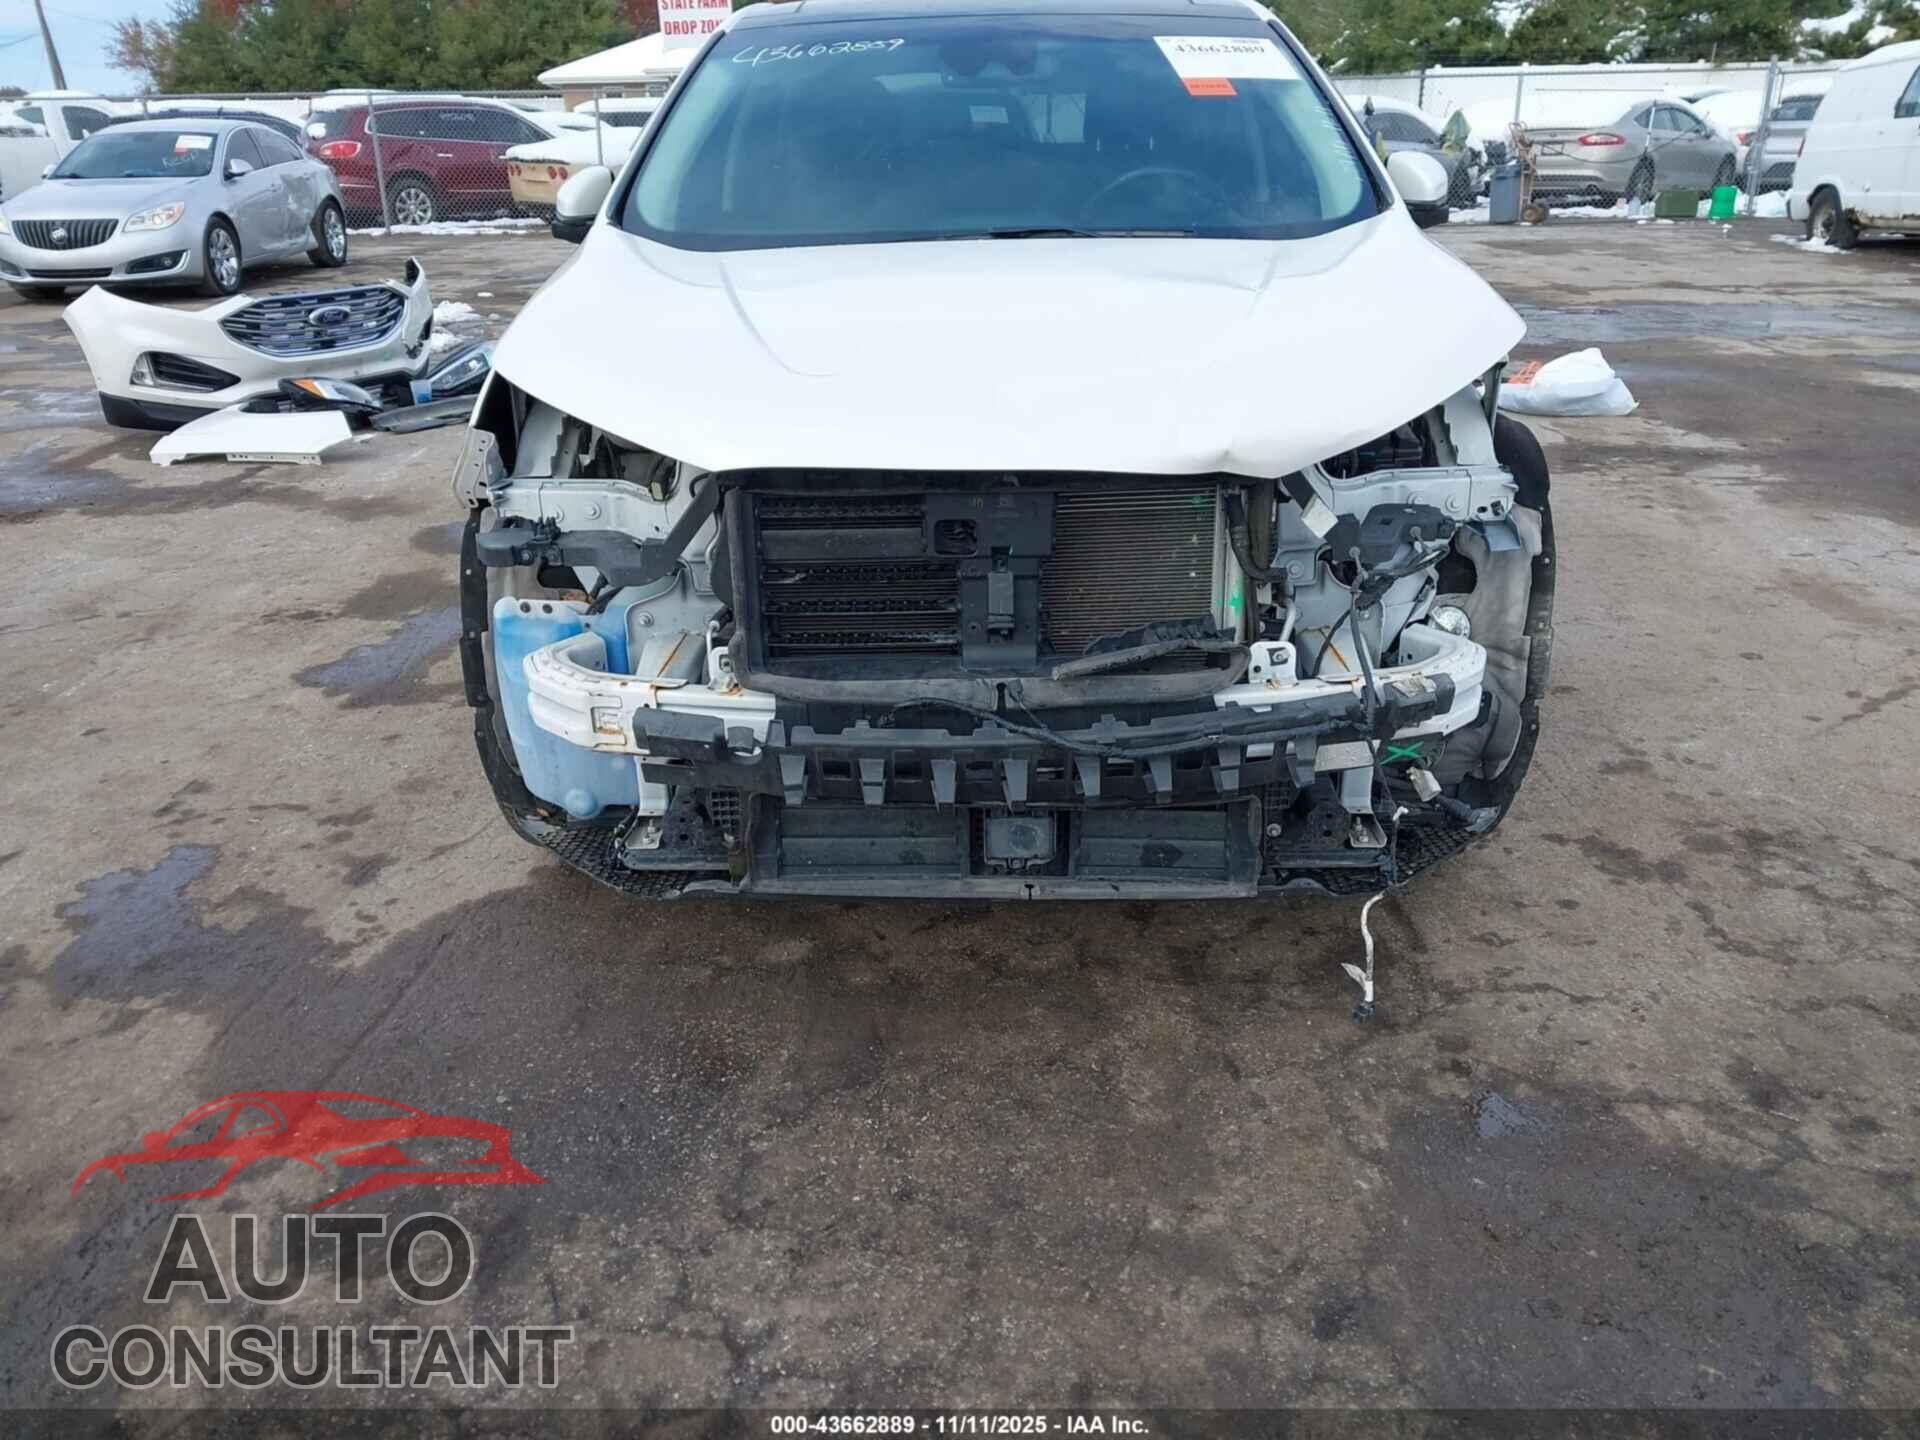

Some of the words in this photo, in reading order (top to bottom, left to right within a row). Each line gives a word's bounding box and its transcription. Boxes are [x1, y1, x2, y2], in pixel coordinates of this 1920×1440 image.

[661, 0, 695, 9] STATE
[698, 0, 728, 8] FARM
[664, 20, 697, 35] DROP
